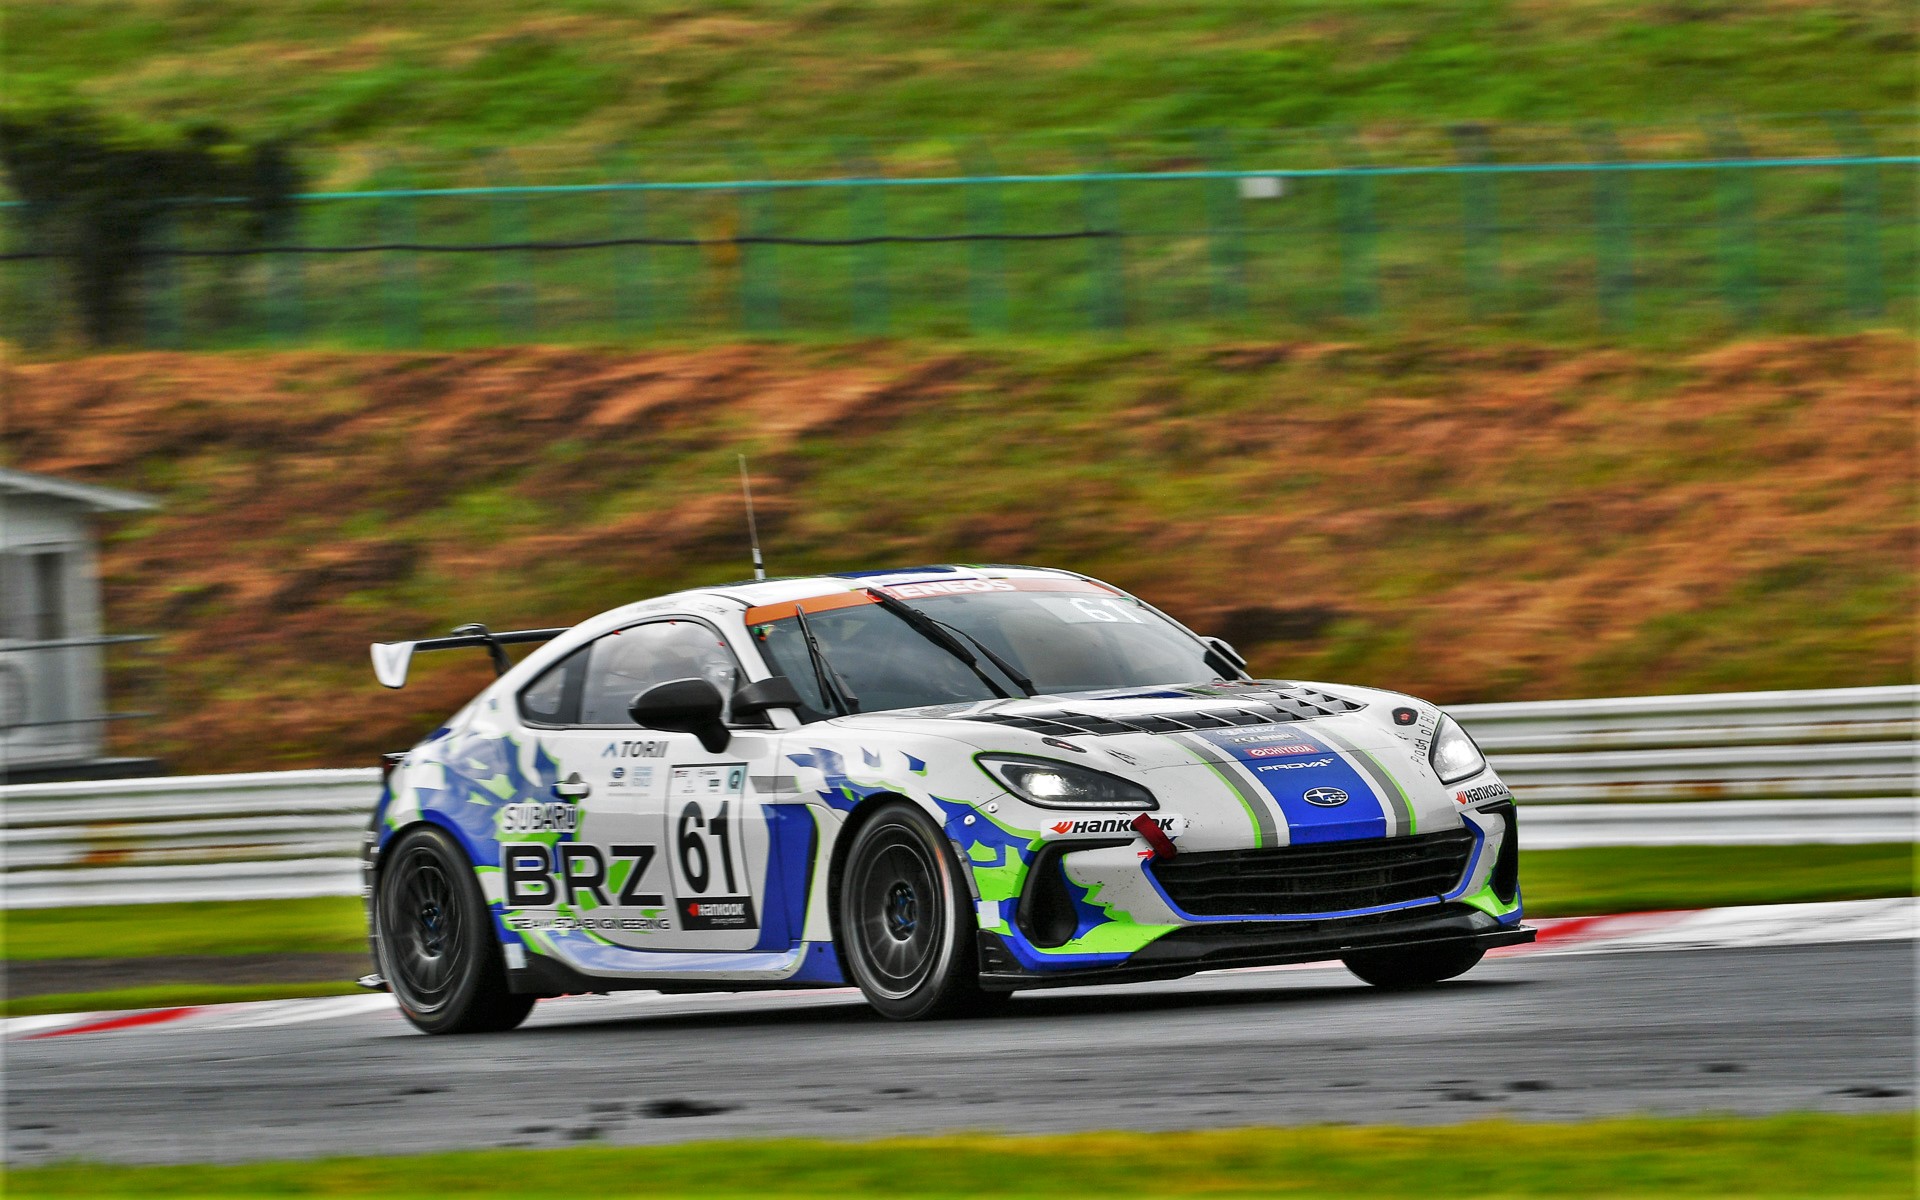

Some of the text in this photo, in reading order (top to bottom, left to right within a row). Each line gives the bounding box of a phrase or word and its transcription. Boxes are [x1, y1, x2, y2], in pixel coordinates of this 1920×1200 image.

[898, 579, 1017, 598] ENEOS
[1069, 597, 1143, 624] 61
[621, 741, 669, 758] TORII
[1264, 744, 1315, 757] CHIYODA
[1257, 759, 1328, 773] PROVA
[504, 804, 578, 831] SUBARU
[1072, 818, 1175, 833] HANKK
[677, 800, 738, 895] 61
[502, 843, 665, 907] BRZ
[584, 917, 671, 930] ENGINEERING
